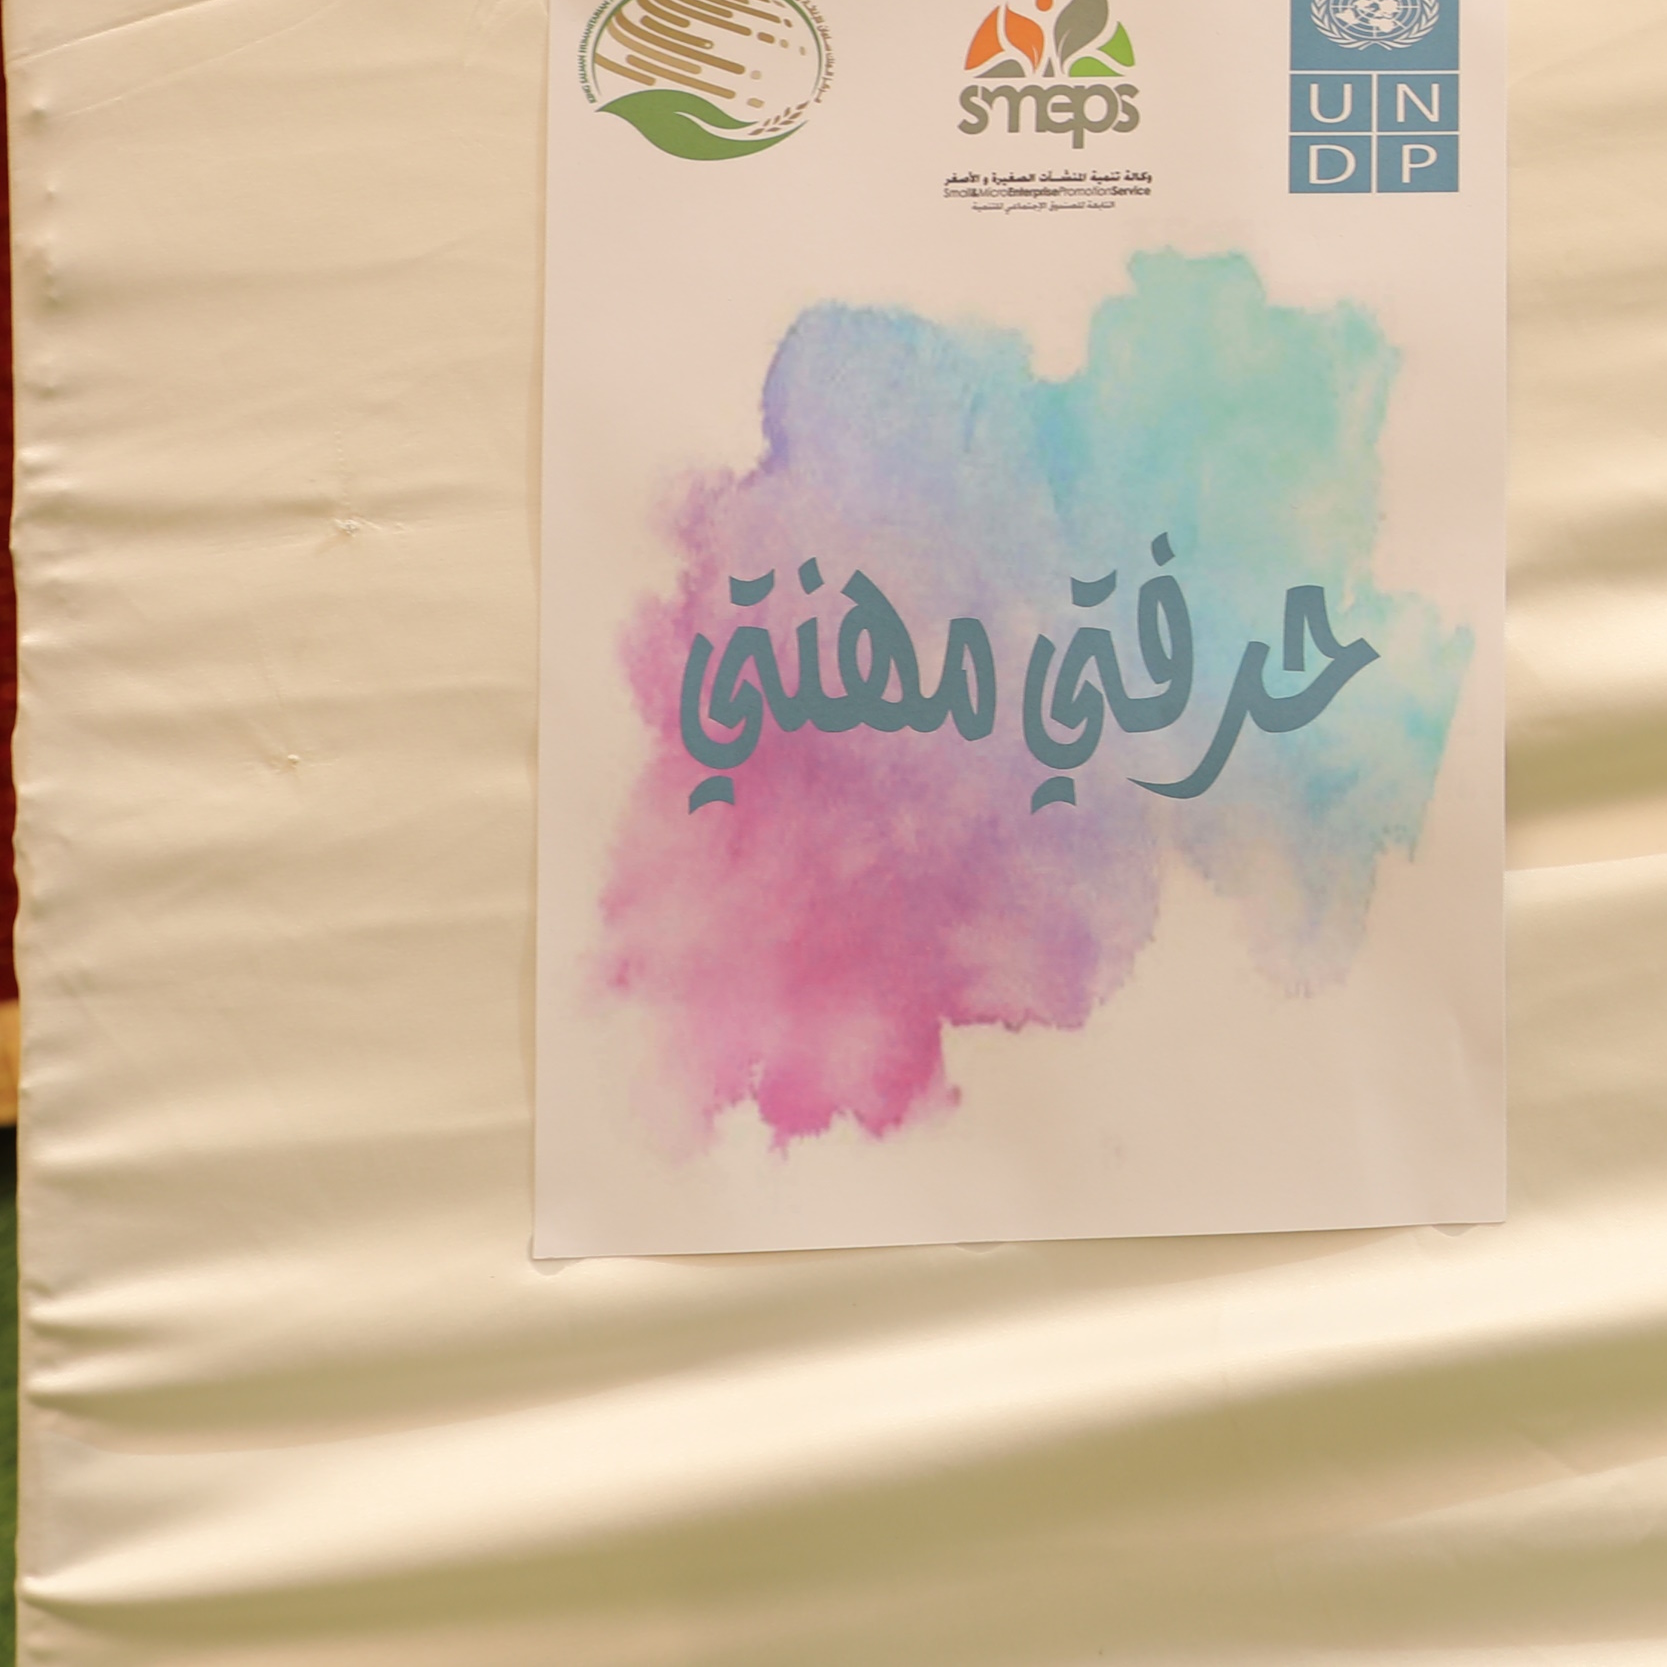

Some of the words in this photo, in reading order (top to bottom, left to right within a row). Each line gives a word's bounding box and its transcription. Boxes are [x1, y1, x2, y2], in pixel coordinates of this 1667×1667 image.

[578, 0, 611, 54] HUMANITARIAN
[957, 83, 1140, 150] smeps
[680, 556, 997, 815] مهنتي
[1022, 531, 1381, 815] حرفتي
